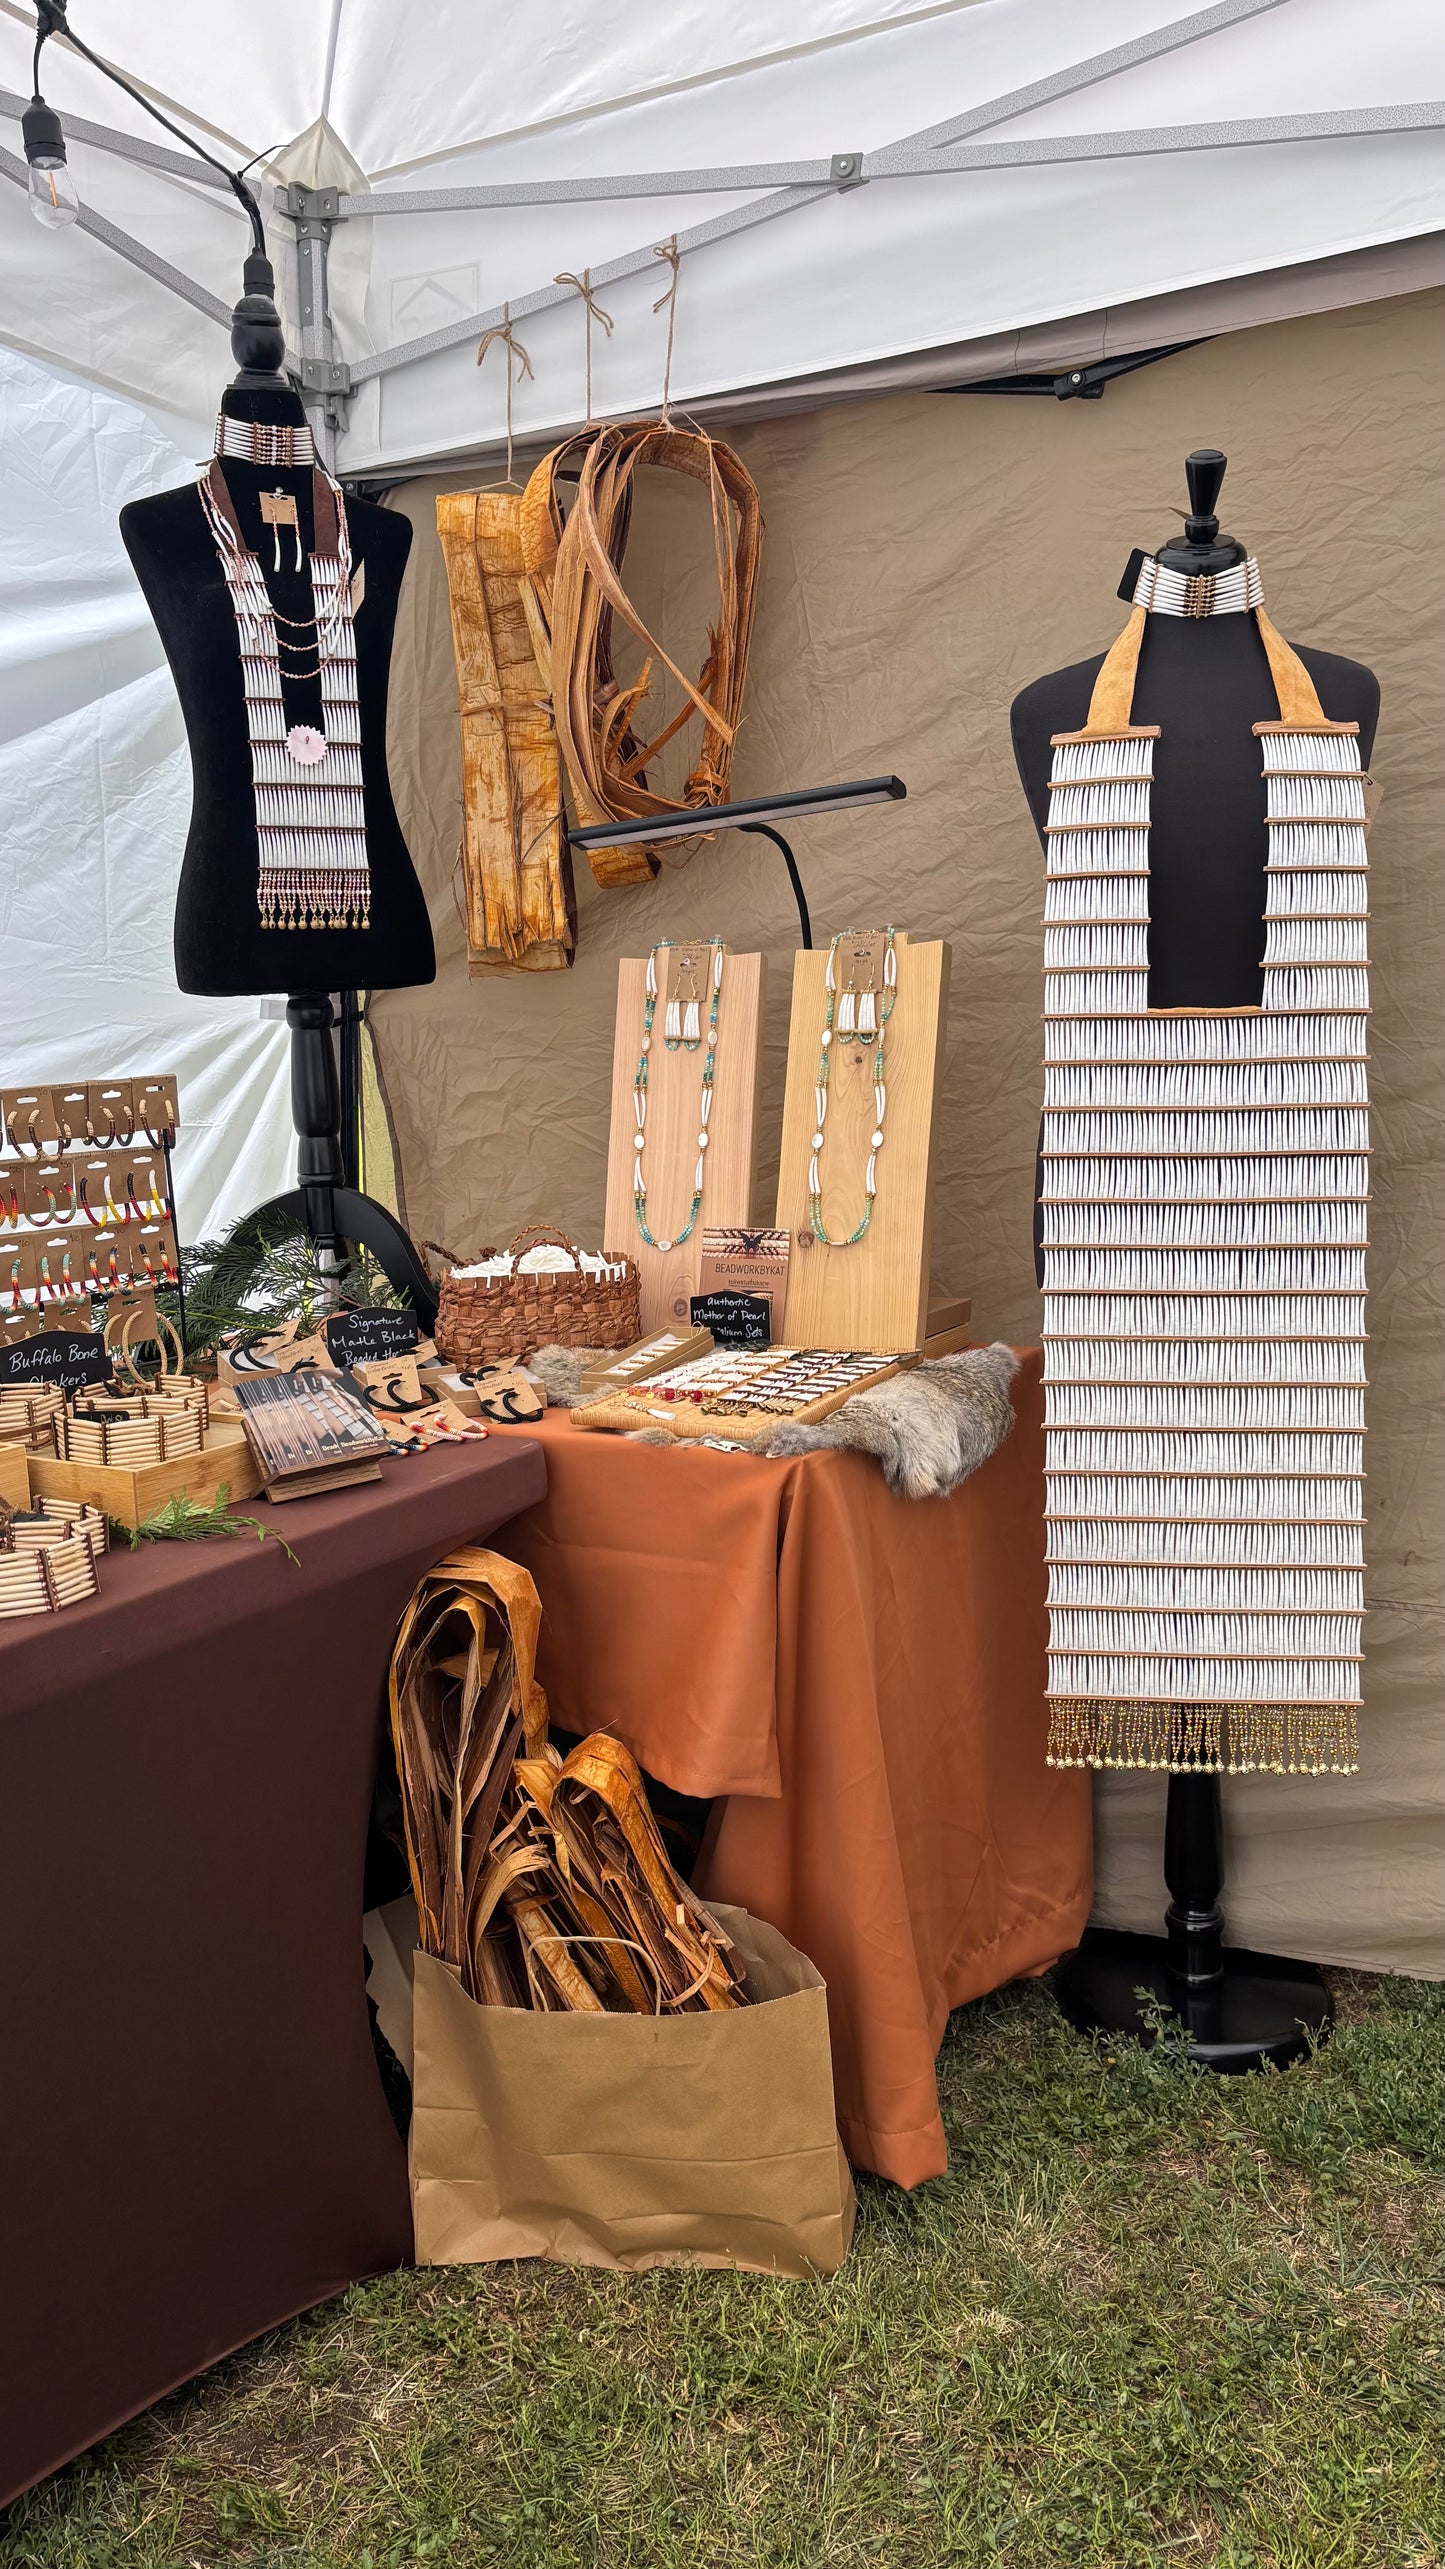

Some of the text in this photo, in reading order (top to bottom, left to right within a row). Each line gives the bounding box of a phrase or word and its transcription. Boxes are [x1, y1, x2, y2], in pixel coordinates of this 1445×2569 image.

[715, 1262, 785, 1276] BEADWORKBYKAT
[348, 1314, 404, 1333] Signature
[727, 1309, 738, 1321] of
[331, 1329, 416, 1348] Matte Black
[745, 1323, 763, 1339] Sets
[9, 1343, 99, 1373] Buffalo Bone
